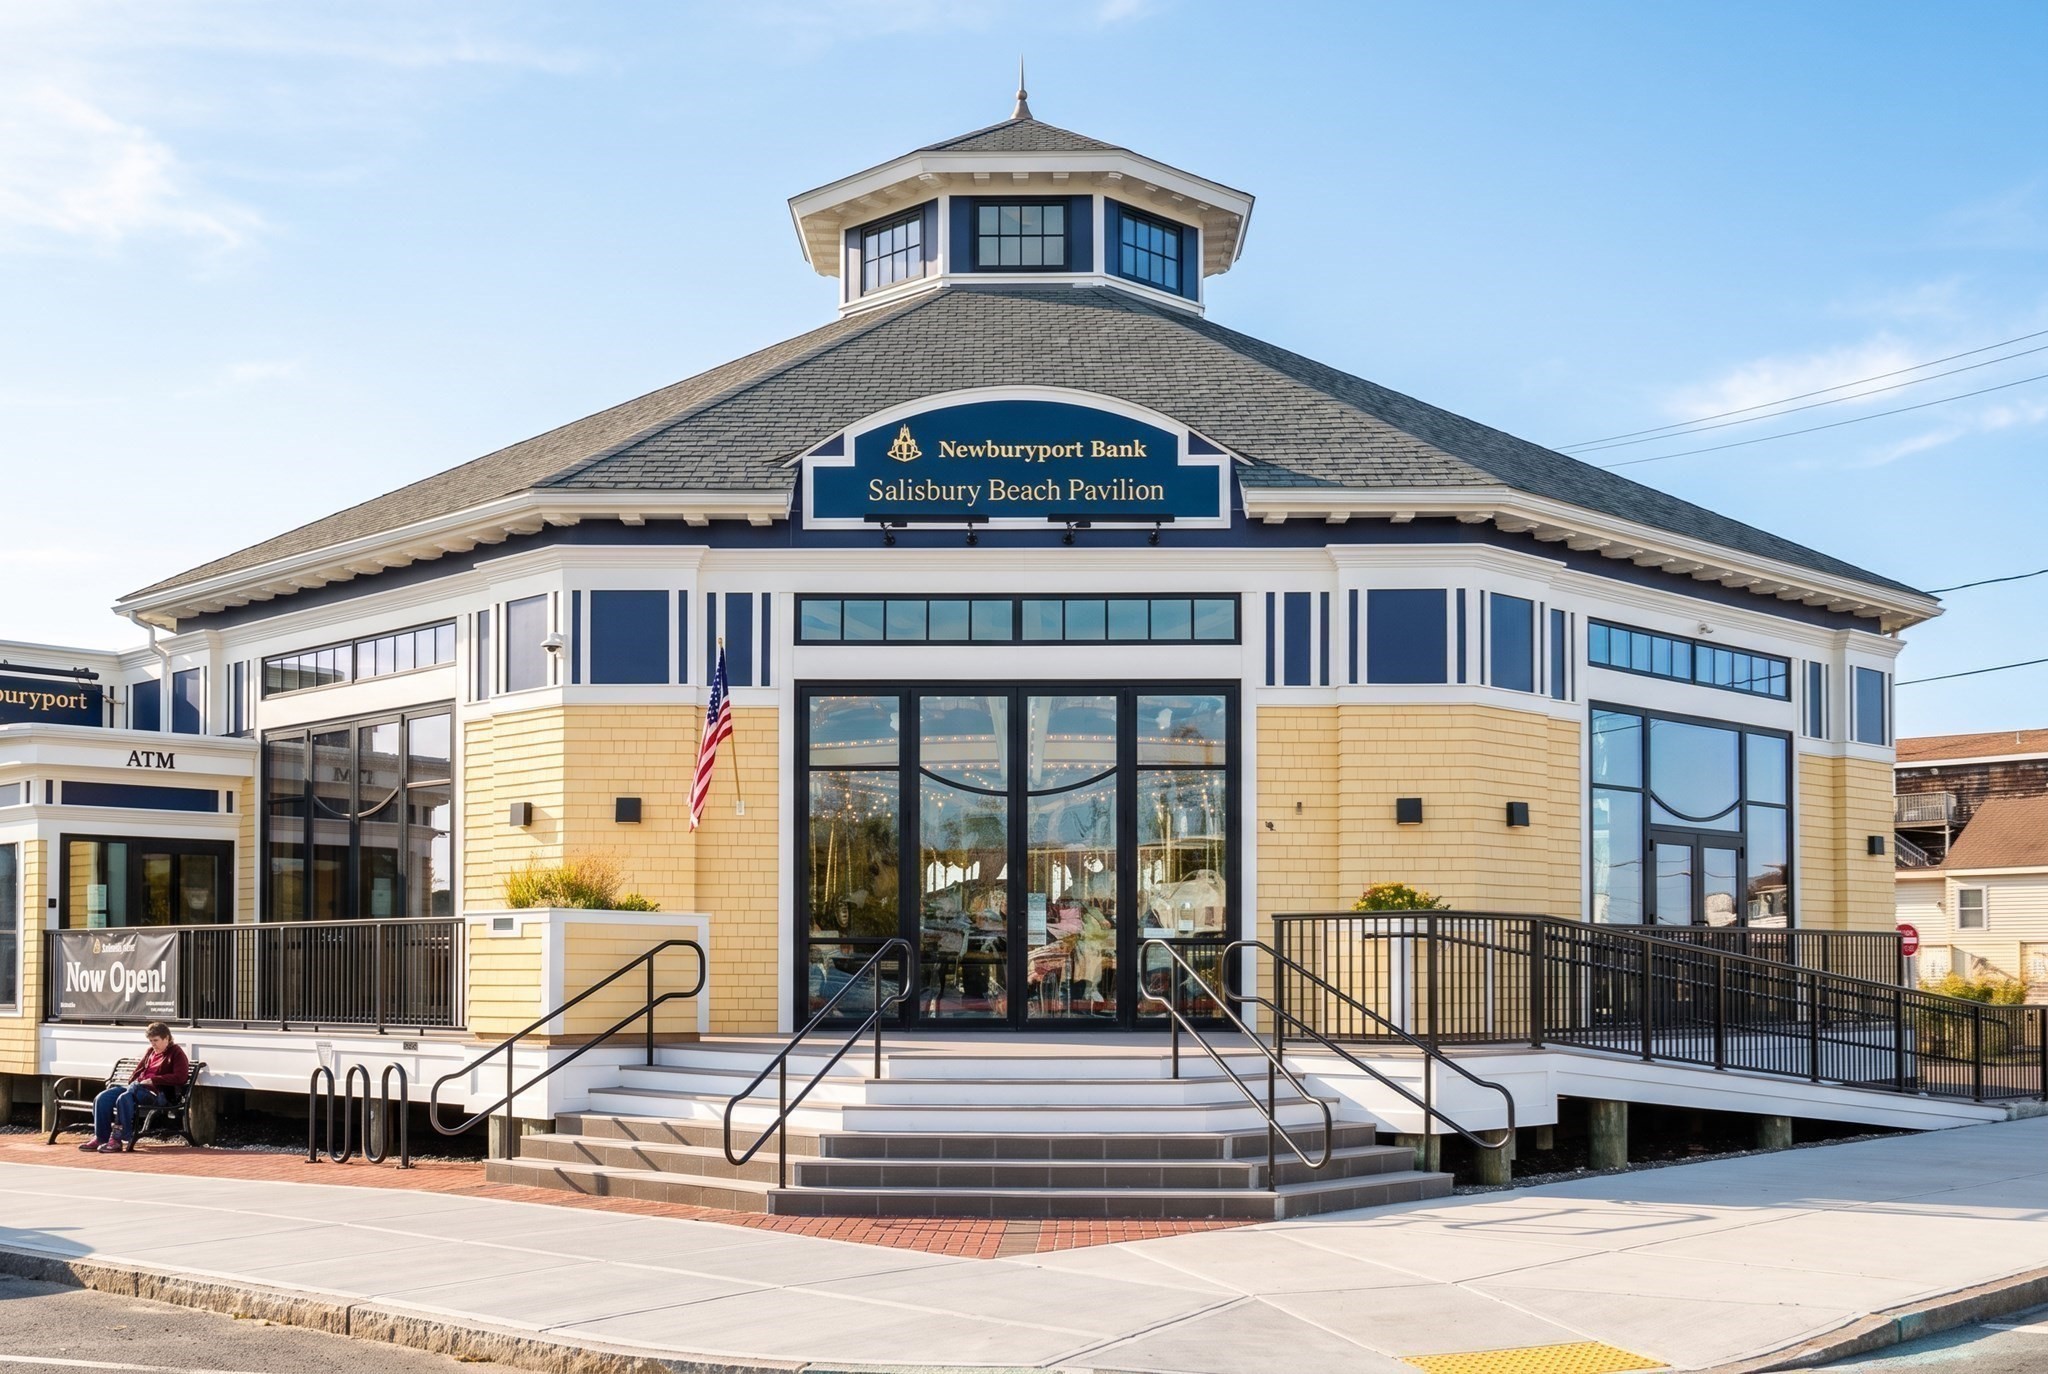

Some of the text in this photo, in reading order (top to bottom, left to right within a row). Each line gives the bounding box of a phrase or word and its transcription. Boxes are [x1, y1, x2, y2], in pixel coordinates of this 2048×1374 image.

[938, 439, 1147, 463] Newburyport Bank
[868, 478, 1165, 507] Salisbury Beach Pavilion
[126, 749, 176, 770] ATM
[65, 960, 167, 1002] Now Open!
